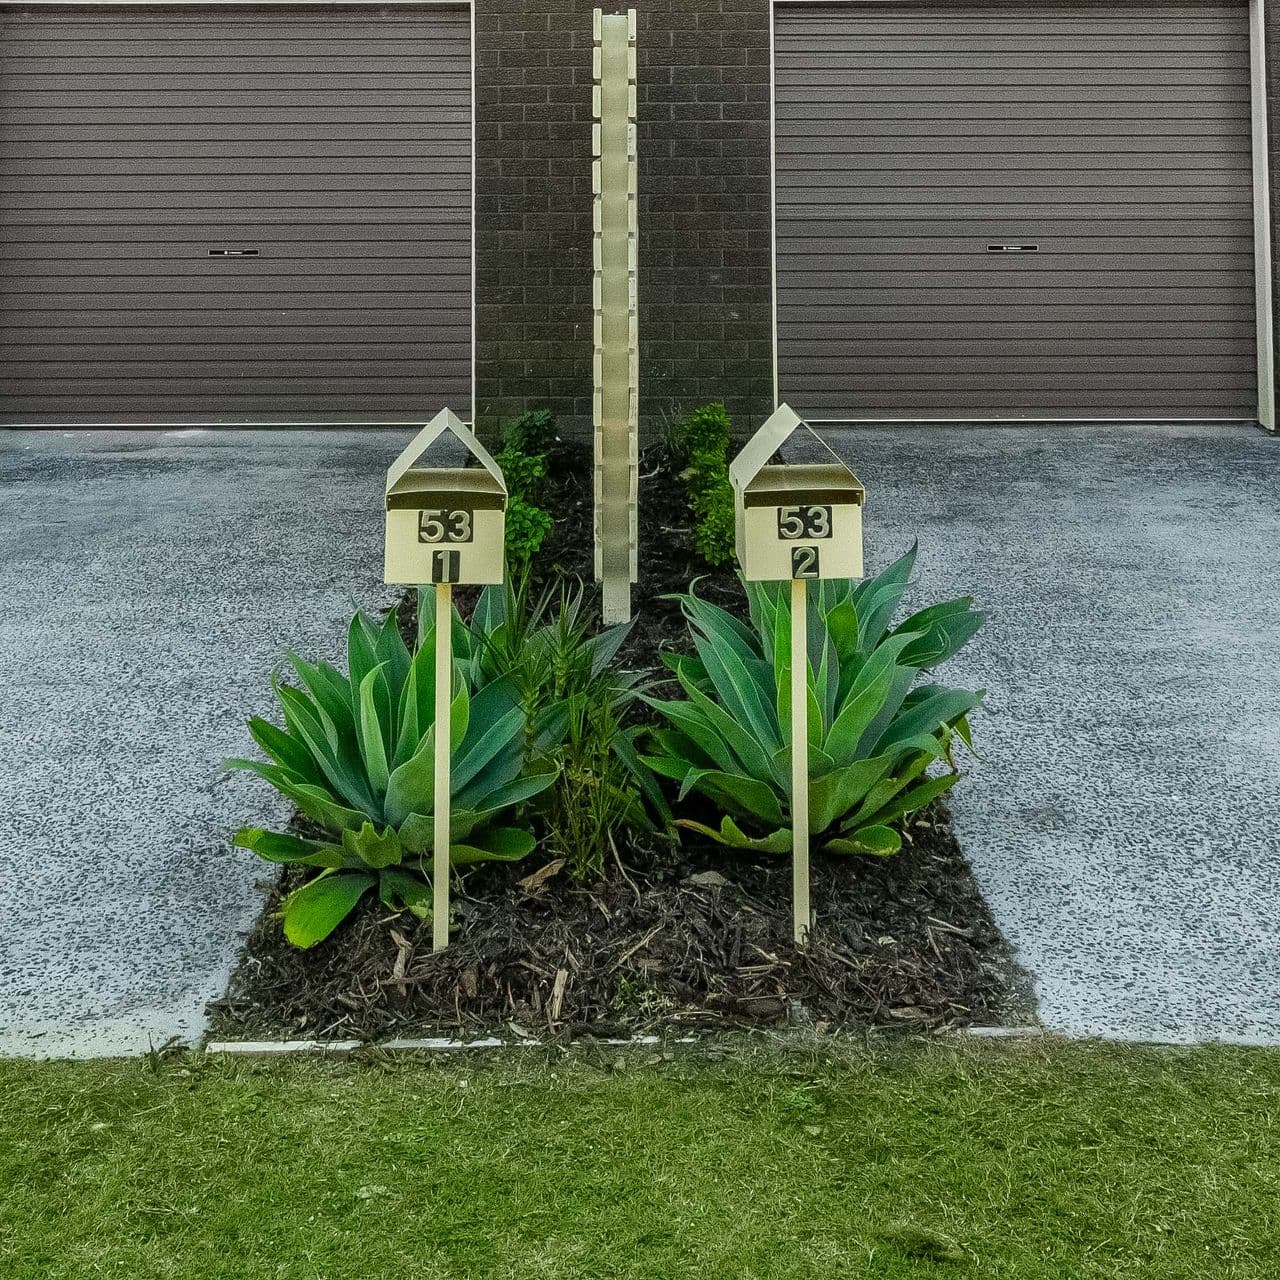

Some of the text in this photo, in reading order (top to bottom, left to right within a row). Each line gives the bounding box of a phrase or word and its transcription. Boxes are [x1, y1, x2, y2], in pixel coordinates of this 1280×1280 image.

[420, 510, 471, 542] 53
[780, 506, 830, 538] 53
[437, 550, 451, 582] 1
[793, 546, 818, 578] 2
